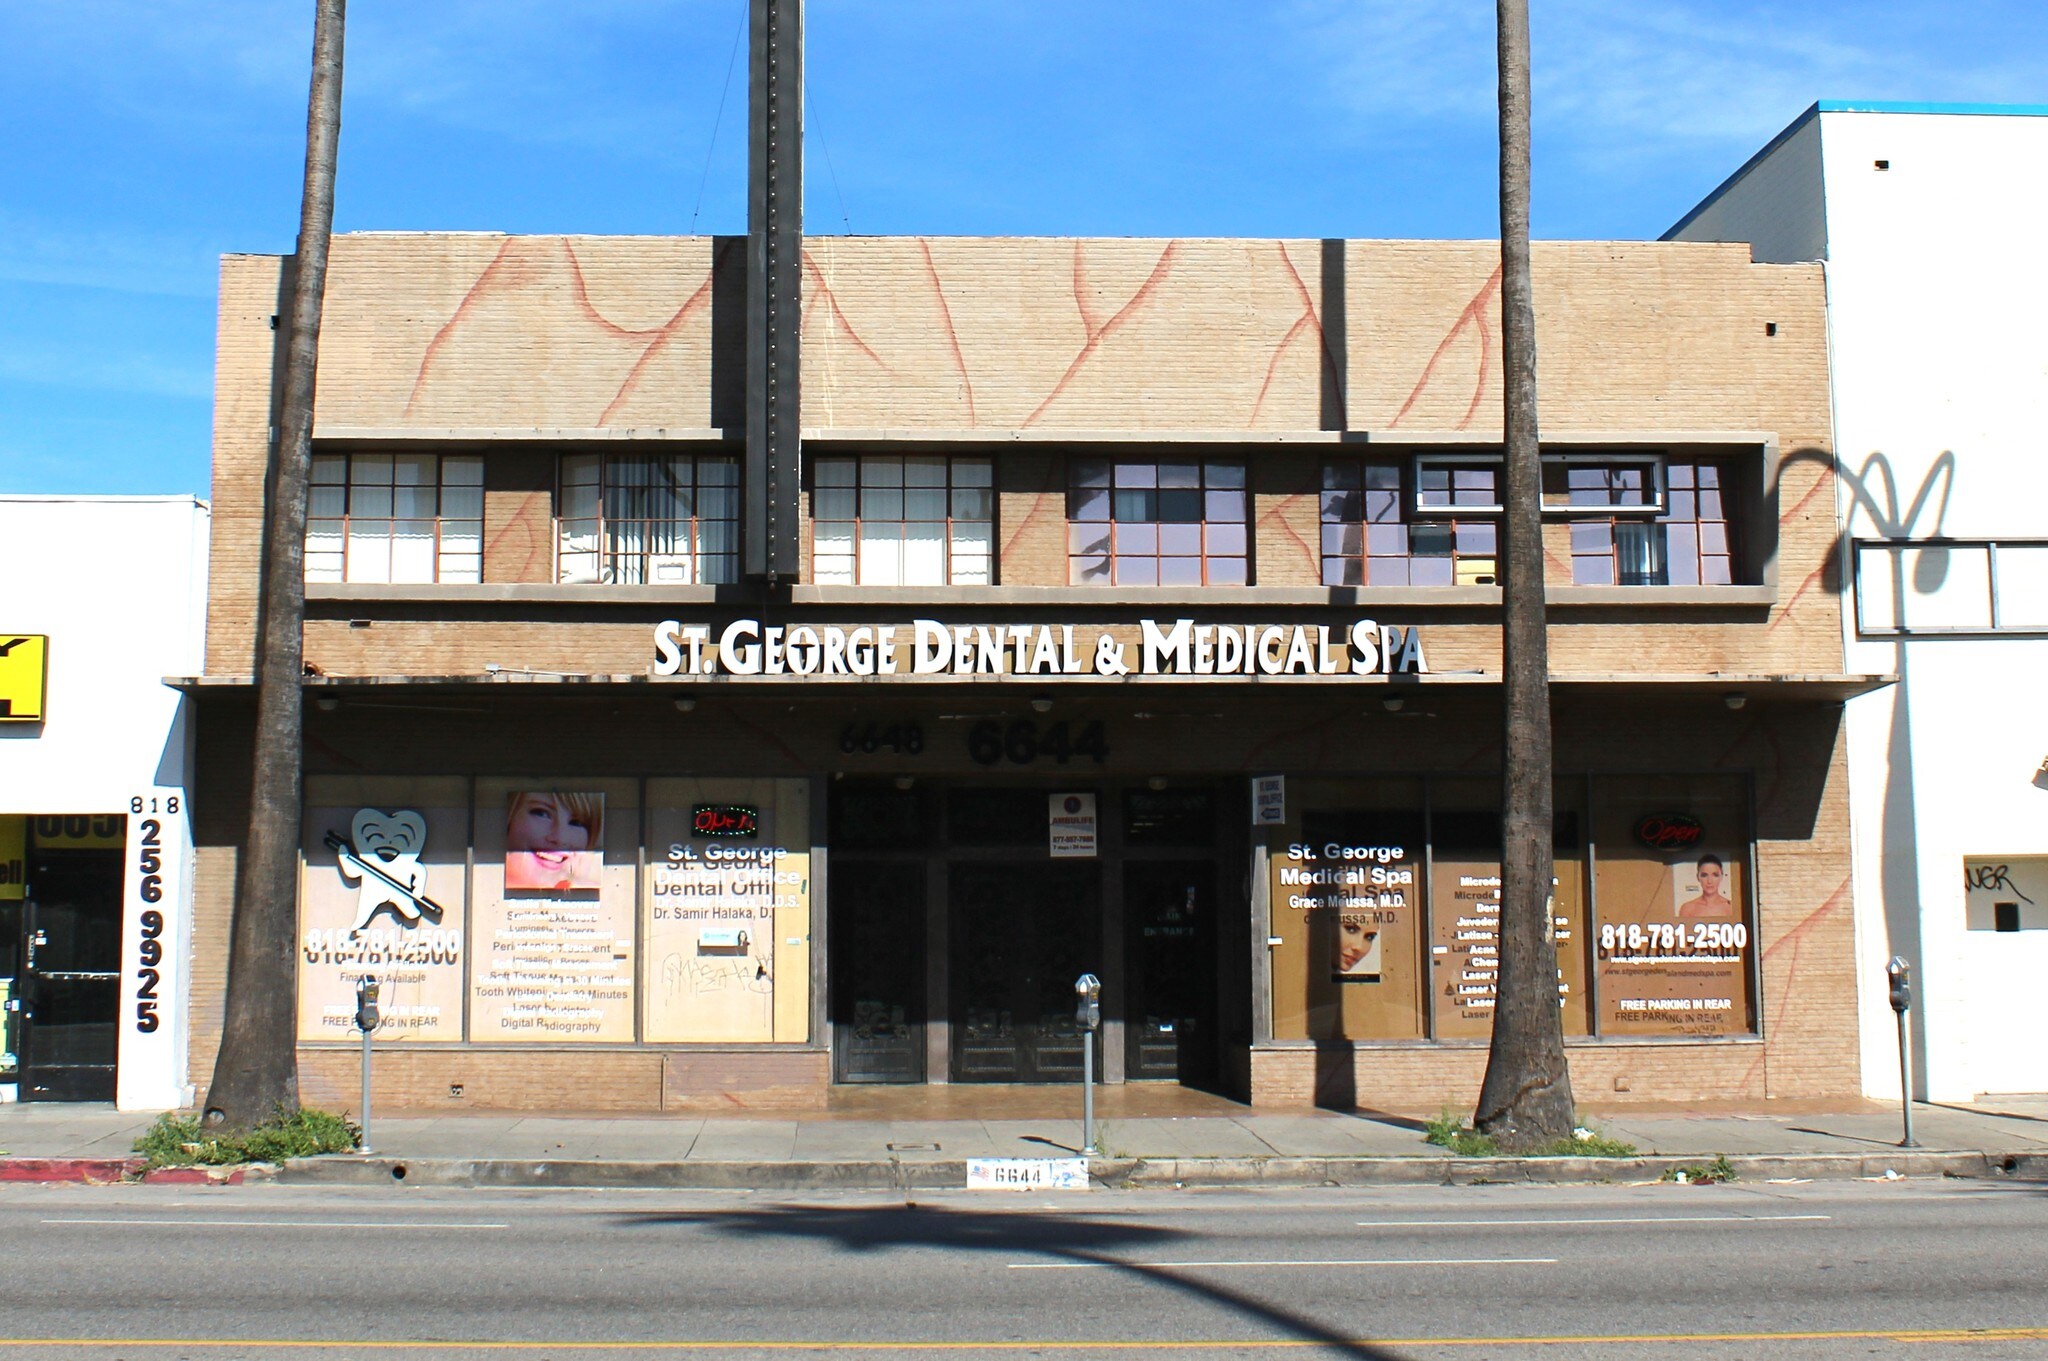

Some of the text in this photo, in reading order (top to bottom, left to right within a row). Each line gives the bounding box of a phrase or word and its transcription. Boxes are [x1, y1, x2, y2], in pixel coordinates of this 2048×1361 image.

[719, 619, 898, 676] GEORGE
[913, 619, 1082, 674] DENTAL
[1095, 634, 1130, 676] &
[1140, 619, 1338, 674] MEDICAL
[1351, 619, 1430, 675] SPA
[968, 719, 1111, 765] 6644
[131, 797, 179, 814] 818
[1641, 818, 1700, 845] Open
[668, 844, 788, 865] St. George
[1287, 843, 1404, 864] St. George
[656, 868, 801, 885] Dental Office
[1280, 867, 1413, 888] Medical Spa
[763, 895, 800, 908] D.D.S.
[1288, 894, 1407, 911] Grace Moussa, M.D.
[306, 928, 461, 954] 818-781-2500
[1601, 923, 1747, 949] 818-781-2500
[1469, 944, 1497, 955] Acne
[1462, 970, 1492, 981] Laser
[1459, 984, 1489, 994] Laser
[1620, 999, 1732, 1010] FREE PARKING IN REAR
[995, 1168, 1041, 1184] 6644
